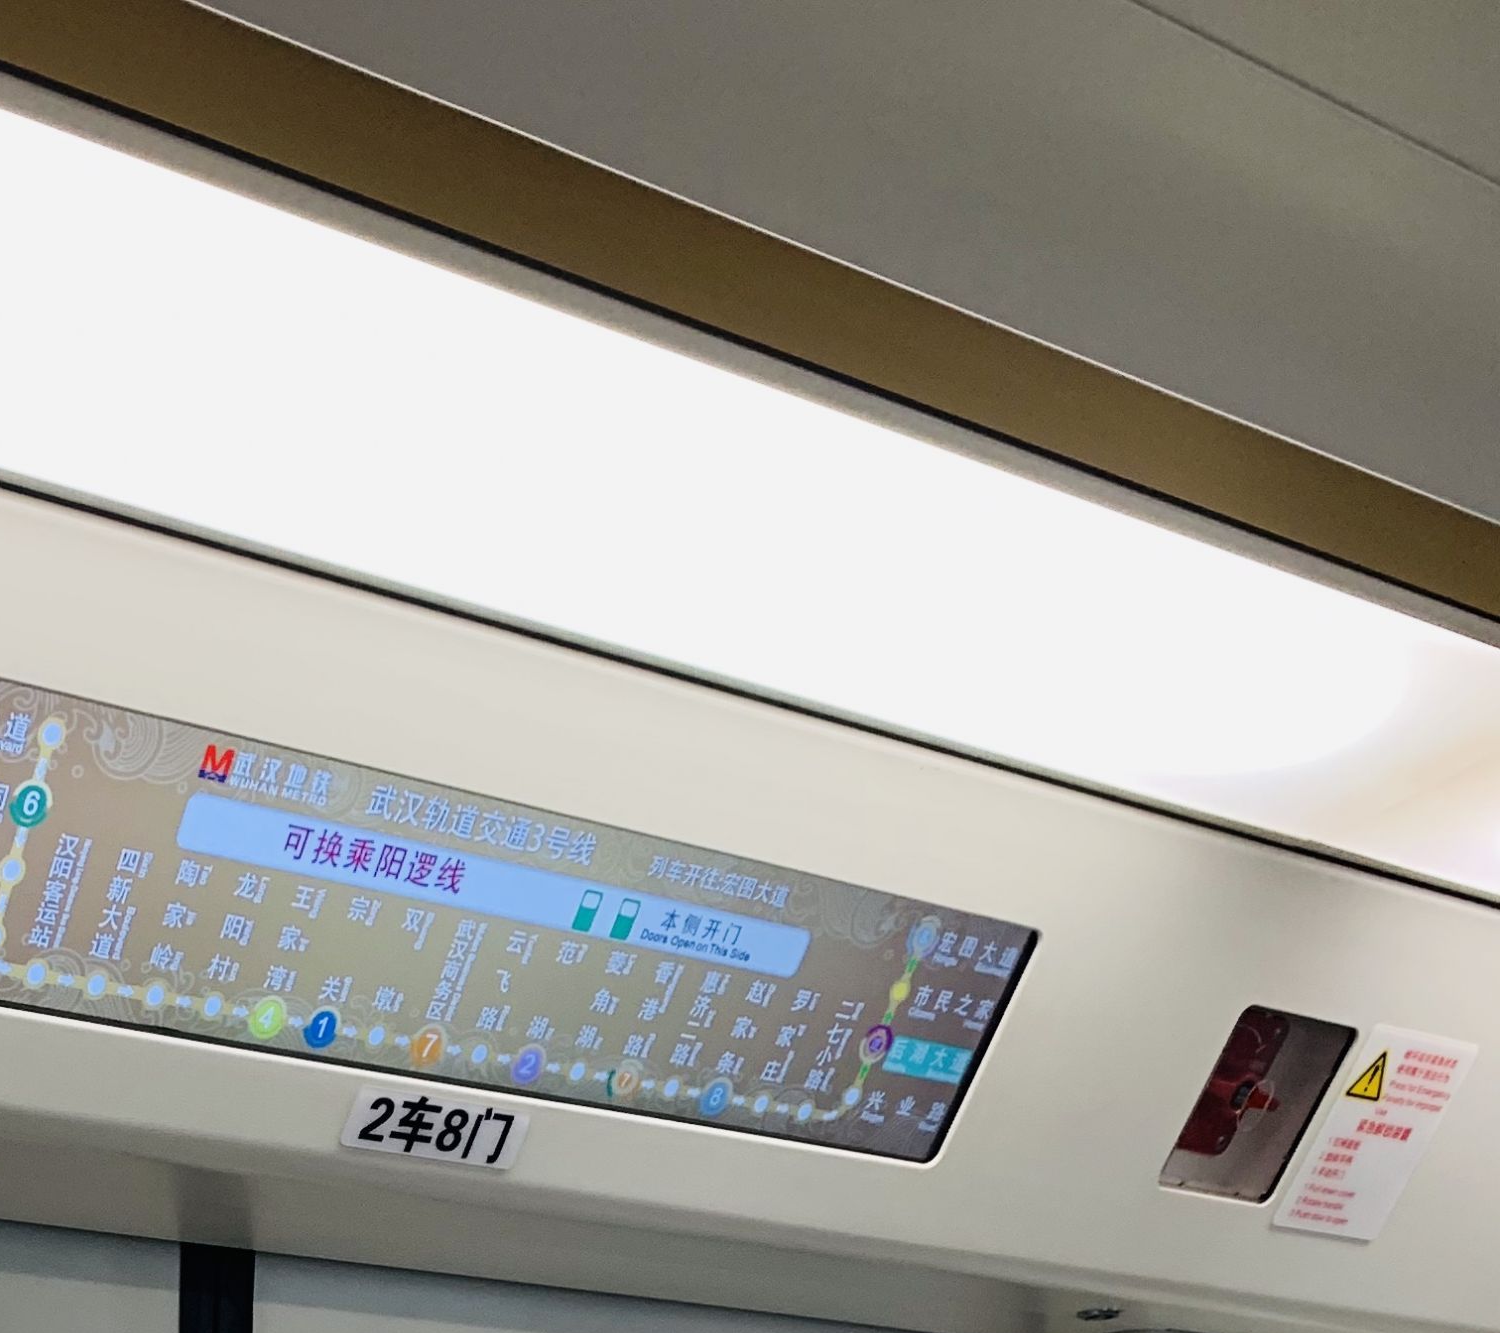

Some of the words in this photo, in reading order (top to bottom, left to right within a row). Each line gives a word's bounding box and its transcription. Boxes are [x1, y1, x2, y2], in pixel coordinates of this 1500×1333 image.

[22, 790, 40, 816] 6
[228, 776, 278, 800] WUHAN
[233, 751, 333, 796] 武汉地铁
[284, 823, 467, 894] 可换乘阳逻线
[365, 784, 597, 867] 武汉轨道交通3号线
[28, 833, 80, 949] 汉阳客运站
[88, 847, 141, 960] 四新大道
[207, 872, 259, 981] 龙阳村
[660, 908, 743, 946] 本侧开门
[263, 885, 315, 992] 王家湾
[318, 896, 369, 1002] 宗关
[358, 1096, 515, 1164] 2车8门
